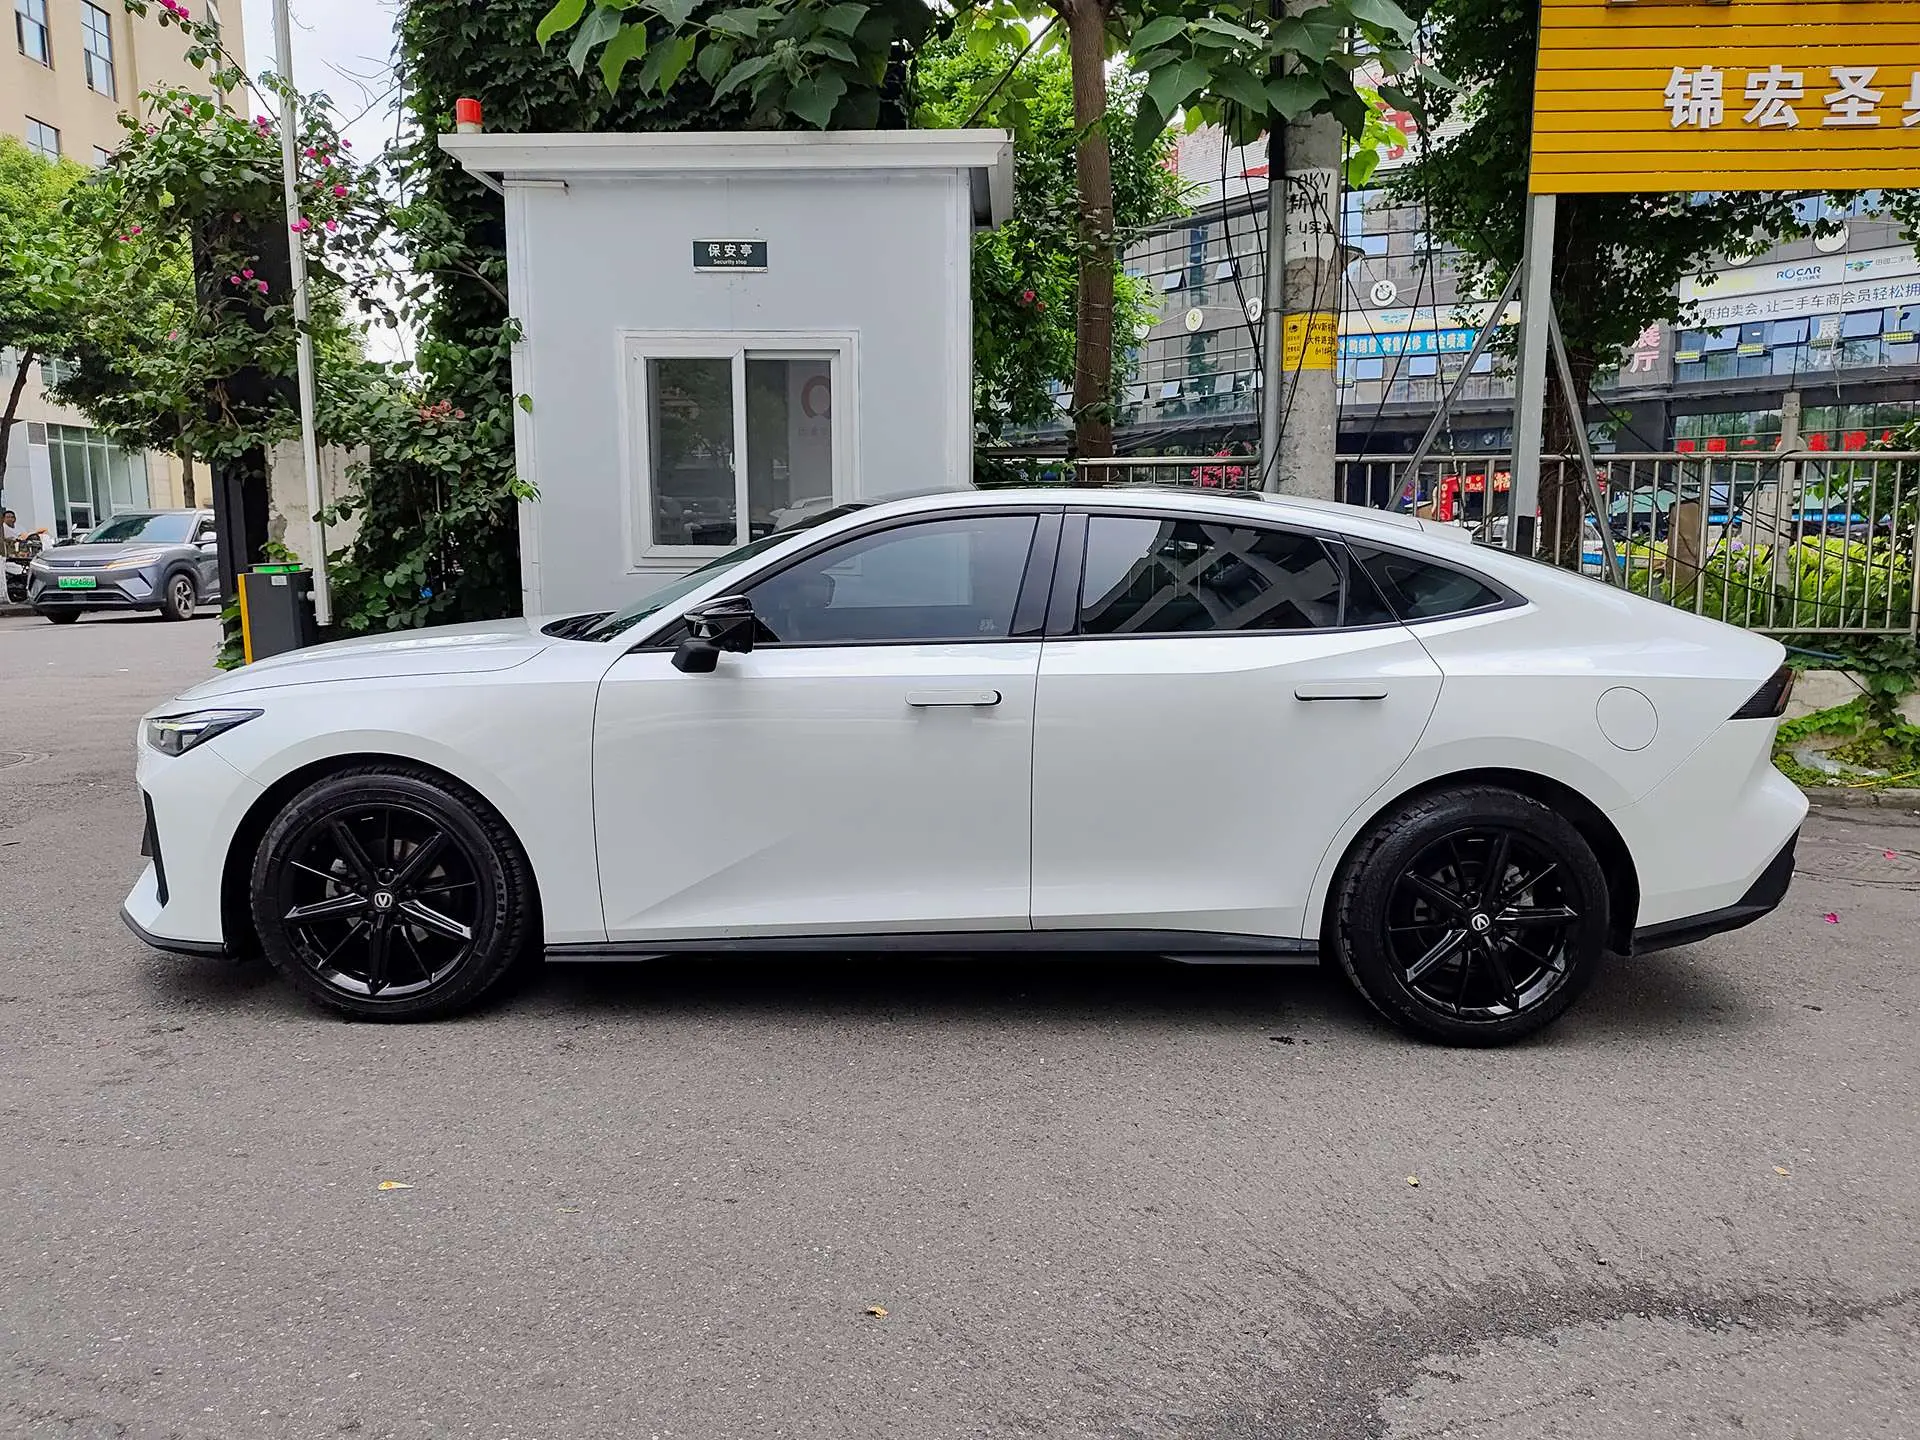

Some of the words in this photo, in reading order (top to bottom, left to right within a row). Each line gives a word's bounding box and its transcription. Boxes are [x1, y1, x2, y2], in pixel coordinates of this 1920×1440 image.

[708, 243, 752, 257] 保安亭
[1776, 265, 1822, 280] ROCAR
